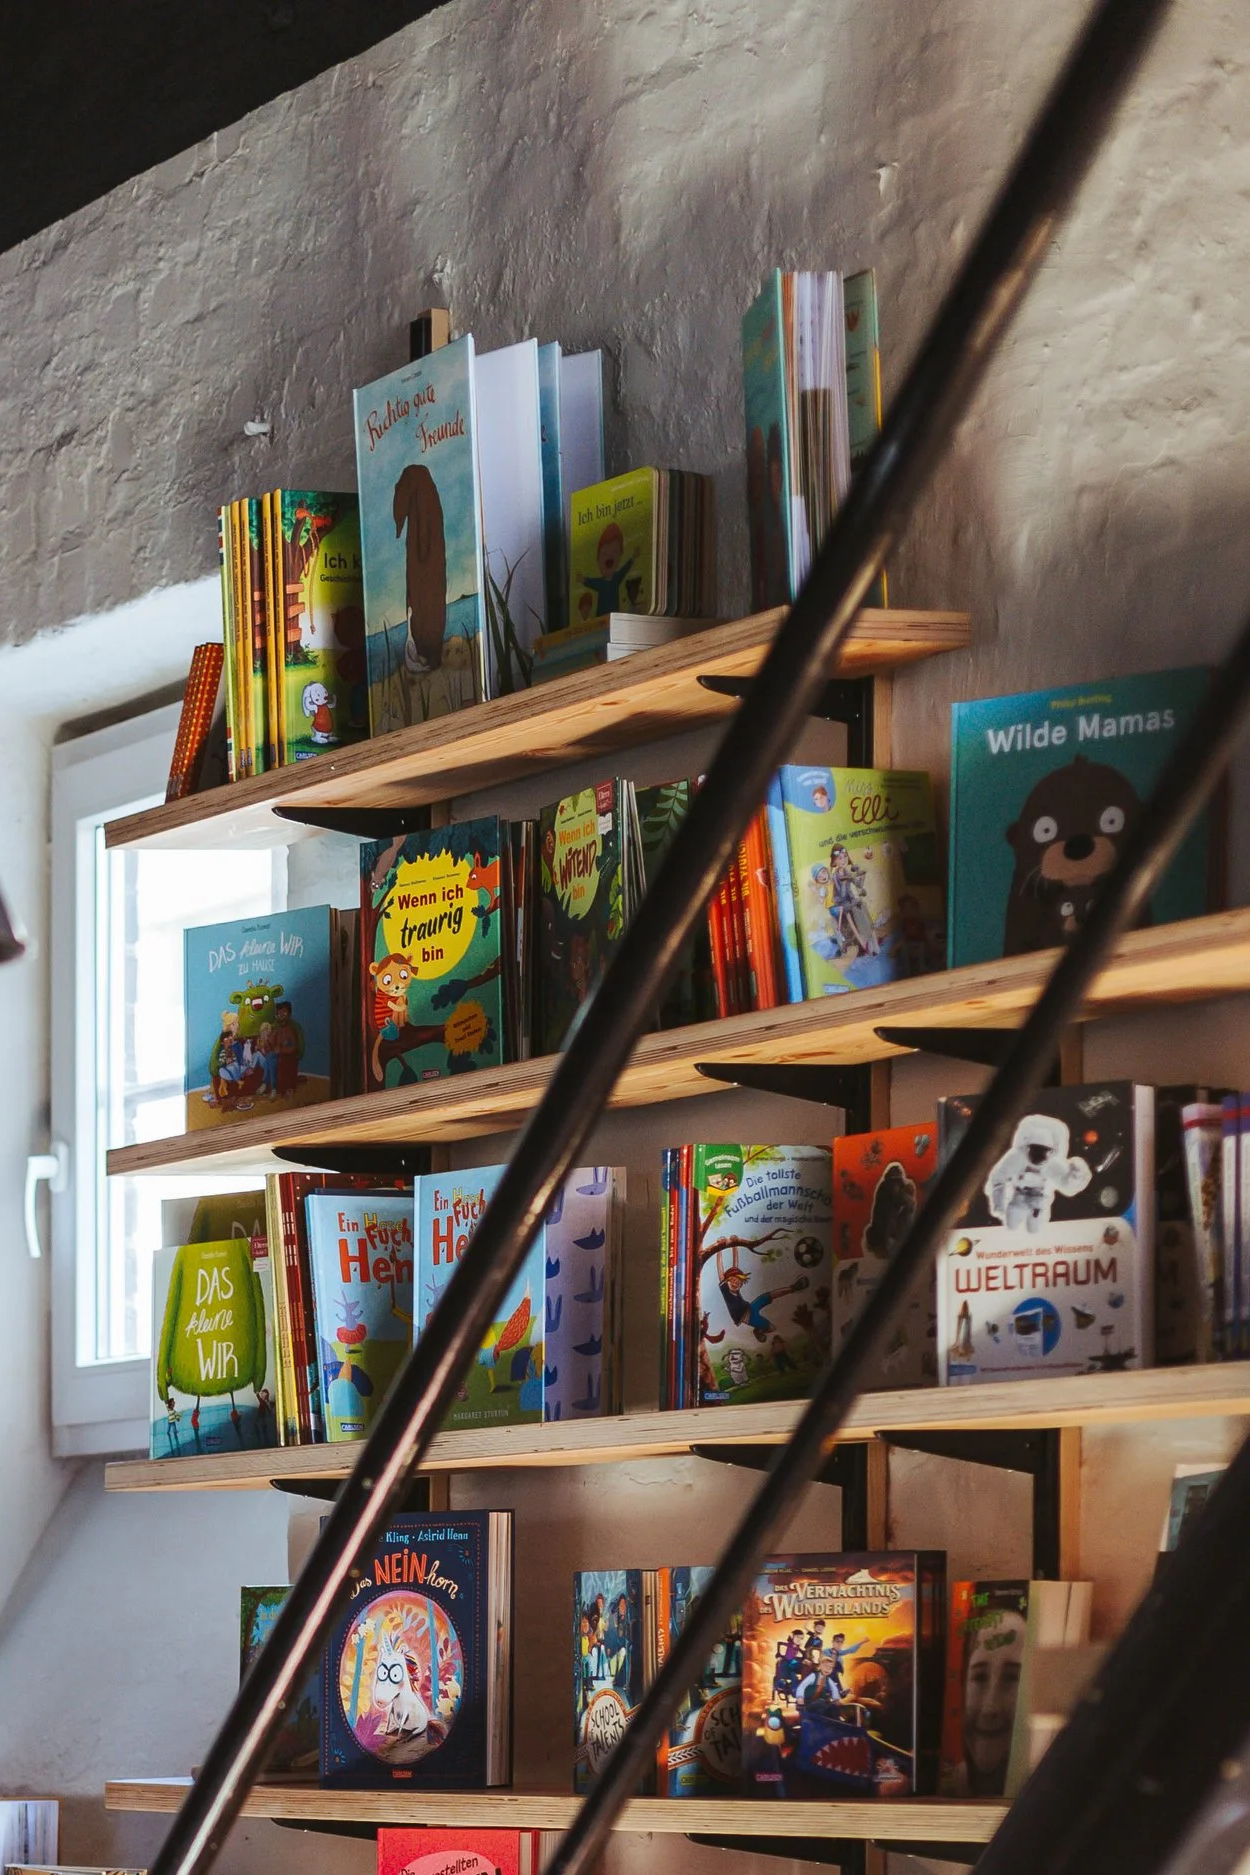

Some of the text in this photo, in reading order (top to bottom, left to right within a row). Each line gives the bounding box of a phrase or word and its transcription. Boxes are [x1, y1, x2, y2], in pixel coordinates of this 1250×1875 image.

[364, 384, 436, 451] Richtig gute
[415, 410, 465, 452] Freunde
[578, 507, 594, 526] Ich
[596, 503, 612, 521] bin
[324, 552, 348, 570] Ich
[988, 708, 1175, 755] Wilde Mamas
[850, 795, 899, 825] Elli
[558, 820, 595, 846] Wenn ich
[398, 884, 464, 910] Wenn ich
[573, 886, 586, 900] bin
[400, 903, 464, 949] traurig
[209, 943, 236, 973] DAS
[280, 931, 303, 958] WIR
[422, 946, 444, 963] bin
[746, 1169, 801, 1188] Die tollste
[434, 1189, 448, 1212] Ein
[724, 1185, 832, 1219] Fußballmannscha
[766, 1199, 813, 1212] der Welt
[337, 1212, 359, 1233] Ein
[745, 1215, 759, 1224] und
[365, 1217, 413, 1250] Fuch
[975, 1244, 1094, 1261] Wunderwelt des Wissens
[195, 1266, 234, 1305] DAS
[955, 1257, 1118, 1294] WELTRAUM
[185, 1309, 233, 1337] kleine
[197, 1339, 238, 1381] WIR
[386, 1530, 468, 1545] Kling Astrid Henn
[764, 1592, 890, 1622] WUNDERLANDS
[591, 1703, 619, 1729] SCHOOL
[711, 1707, 741, 1728] SCH
[591, 1720, 625, 1762] TALENTS
